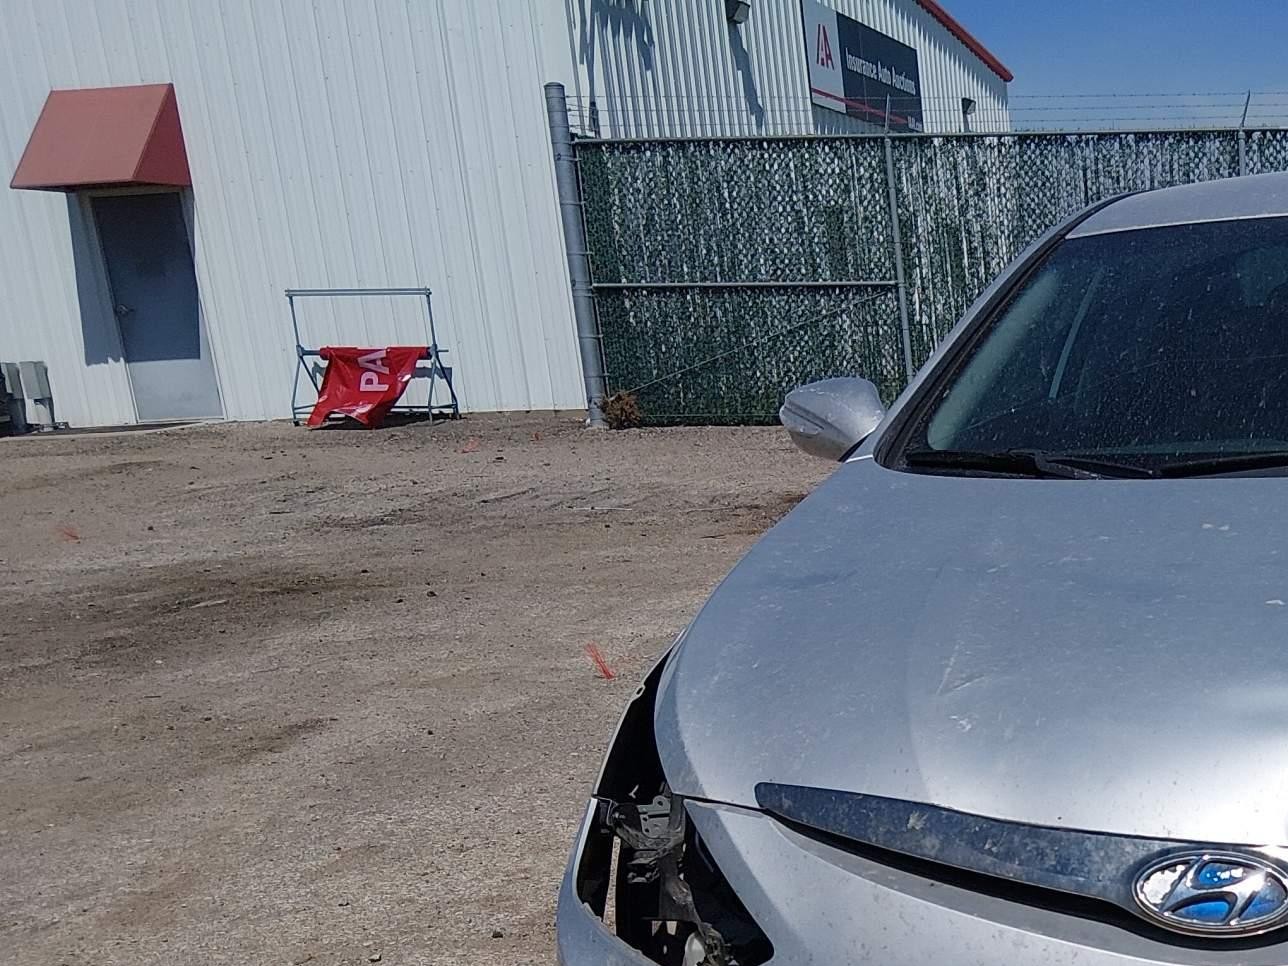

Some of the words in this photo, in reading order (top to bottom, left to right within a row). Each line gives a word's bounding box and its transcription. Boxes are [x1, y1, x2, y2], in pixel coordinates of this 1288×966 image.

[845, 47, 877, 80] Insurance
[878, 60, 892, 86] Auto
[892, 66, 916, 96] Auctions
